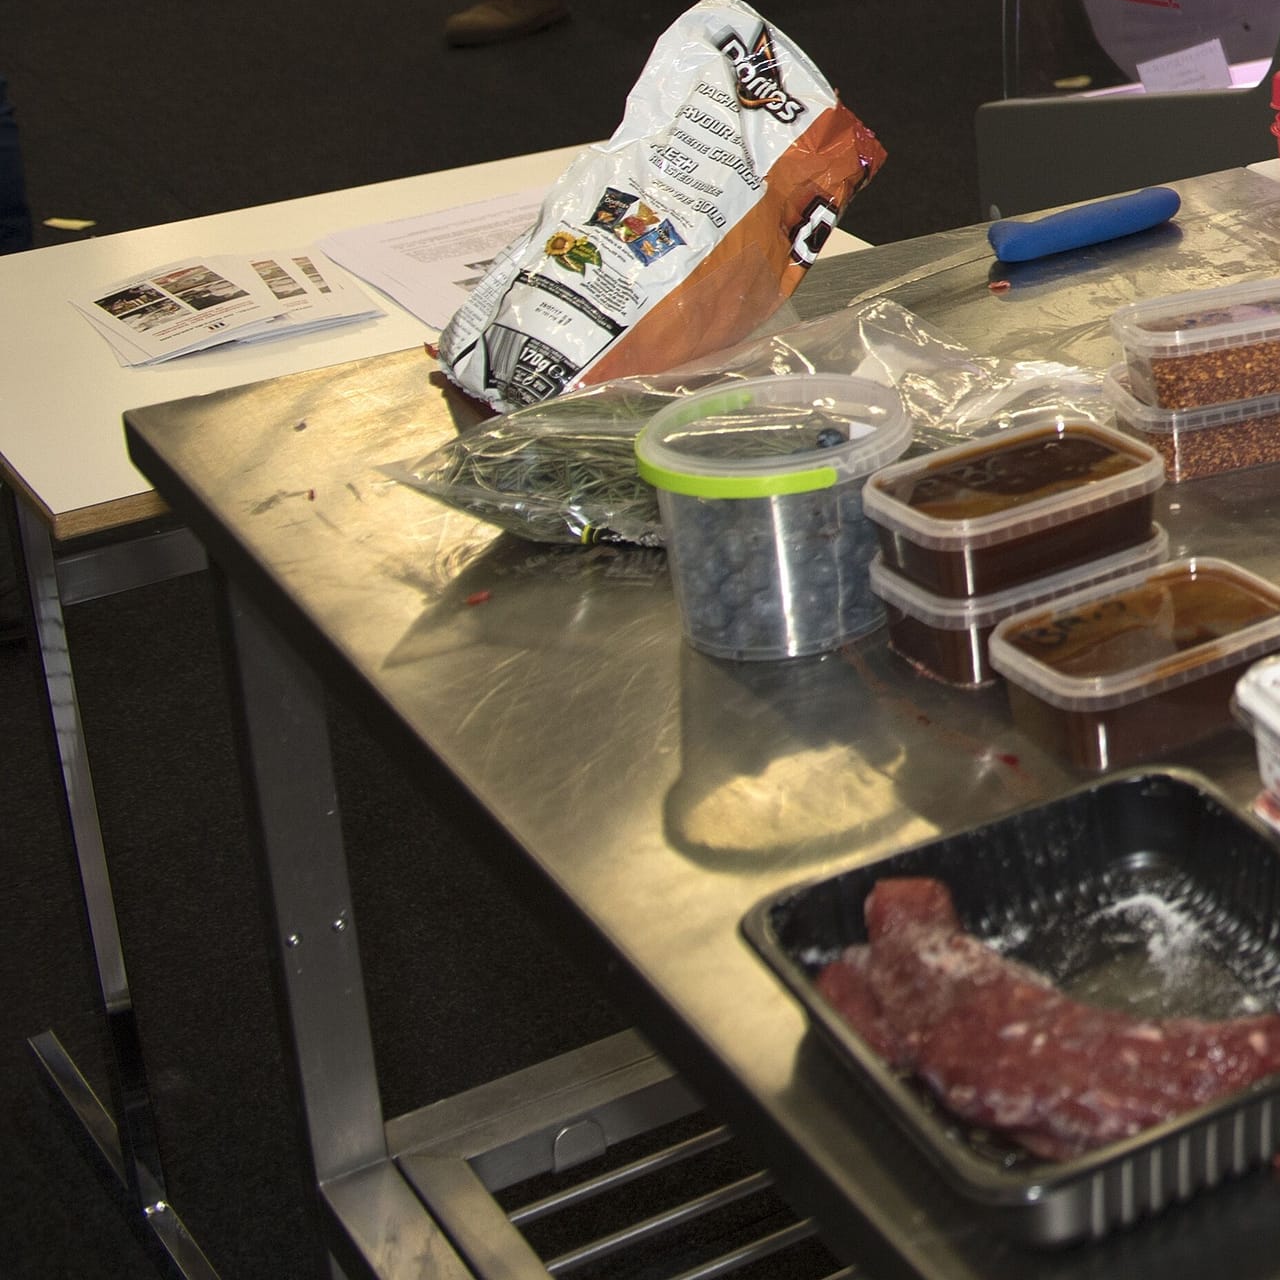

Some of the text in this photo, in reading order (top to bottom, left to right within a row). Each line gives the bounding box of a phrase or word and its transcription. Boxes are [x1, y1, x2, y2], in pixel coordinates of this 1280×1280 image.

[717, 35, 804, 124] Doritos
[676, 104, 735, 140] AVOUR
[672, 128, 711, 155] TREME
[708, 146, 765, 191] CRUNCH
[691, 198, 727, 229] BOLD
[519, 346, 551, 373] 170g
